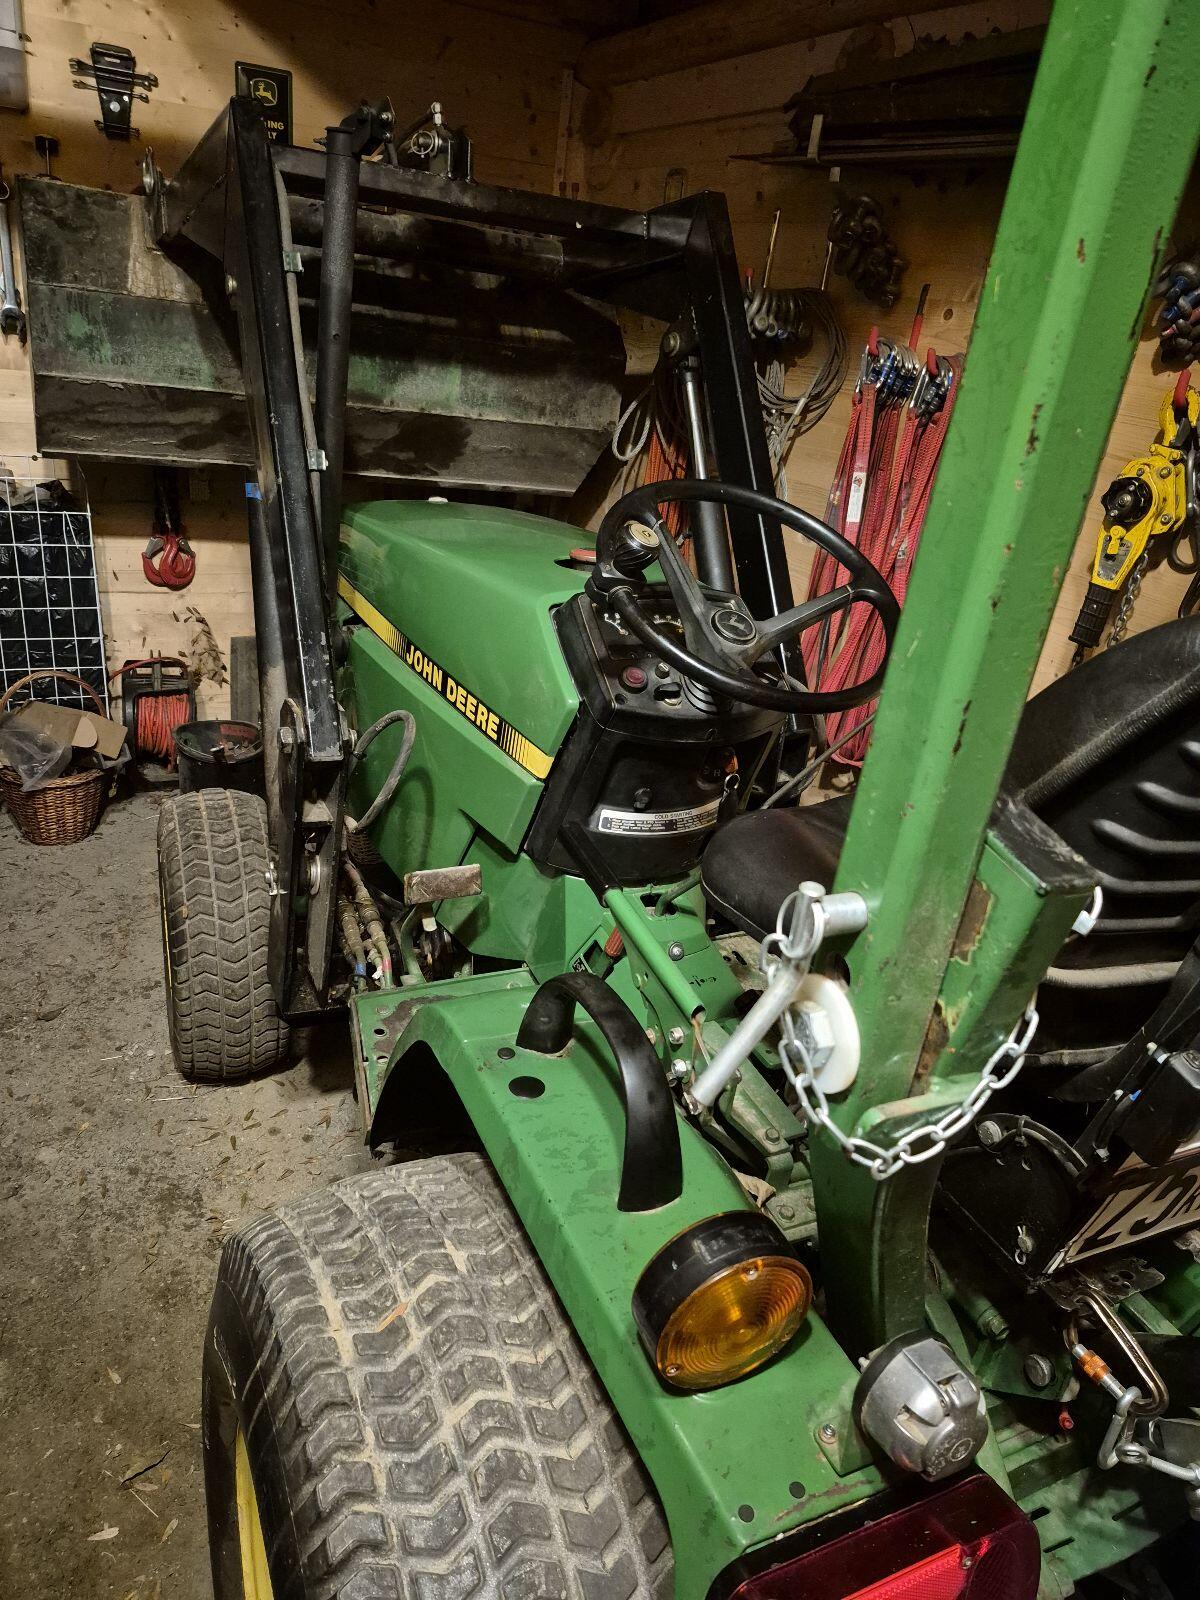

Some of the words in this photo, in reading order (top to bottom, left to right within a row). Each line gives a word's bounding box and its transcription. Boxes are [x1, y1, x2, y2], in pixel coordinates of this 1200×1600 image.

[264, 120, 284, 130] ING
[406, 645, 443, 692] JOHN
[446, 677, 500, 741] DEERE
[670, 810, 693, 819] STARTING
